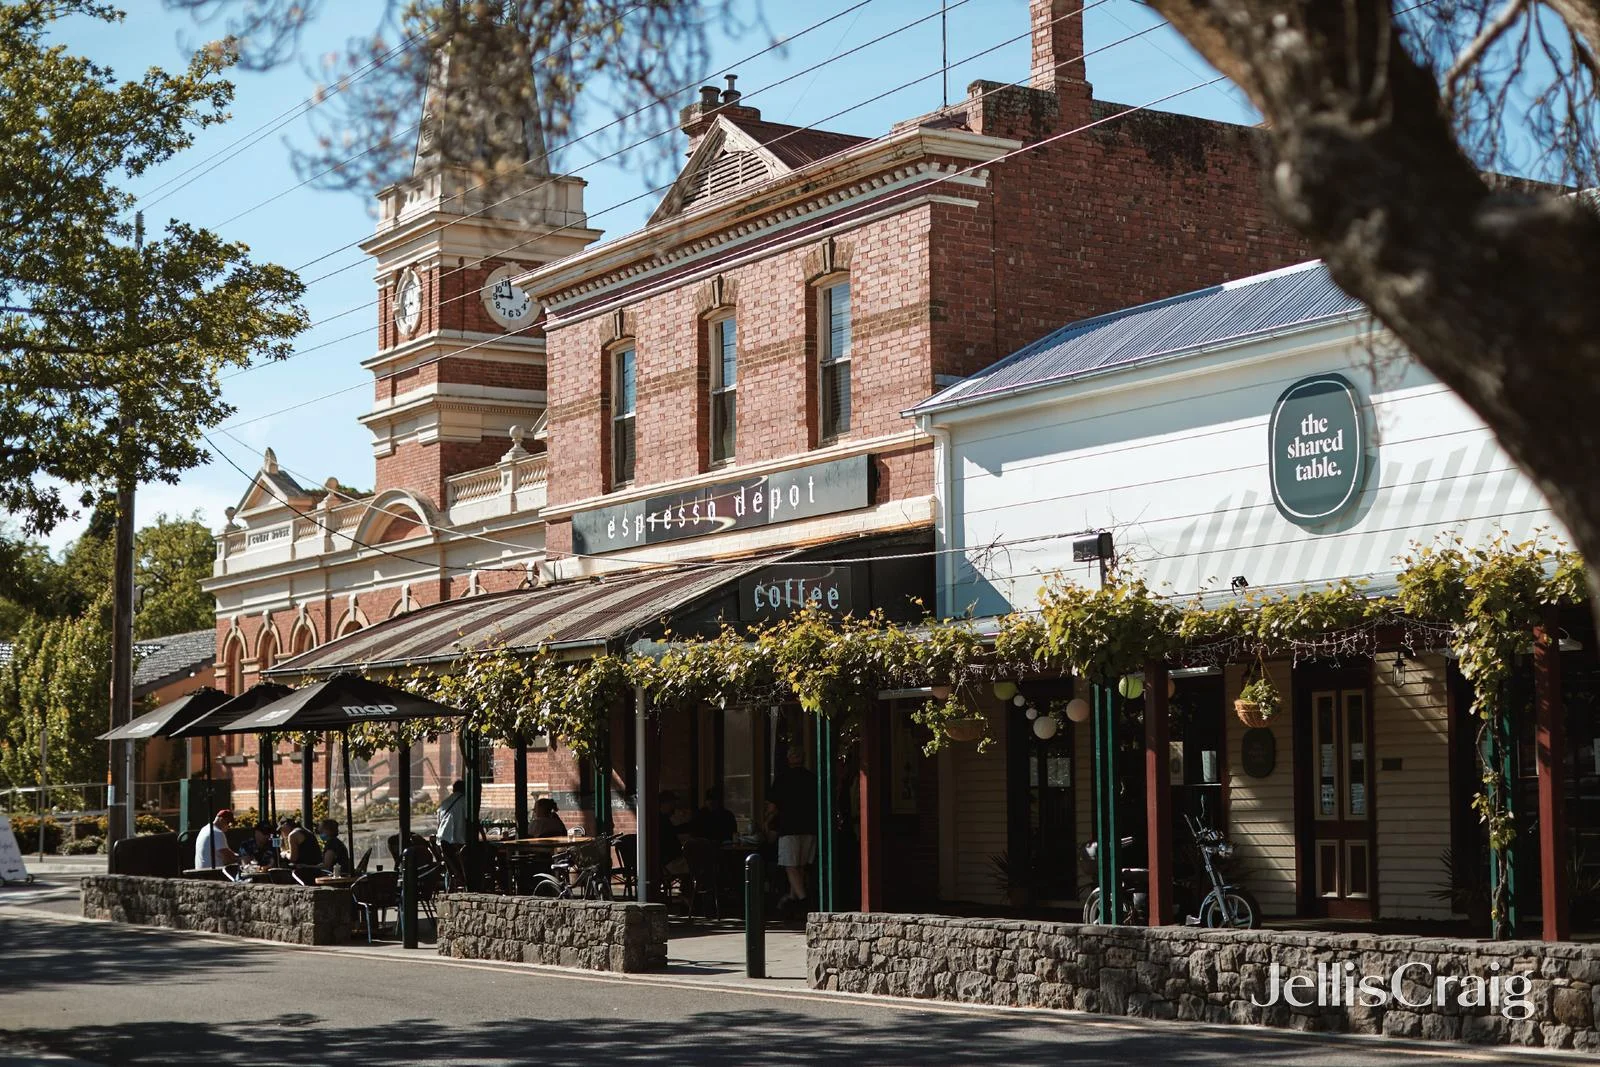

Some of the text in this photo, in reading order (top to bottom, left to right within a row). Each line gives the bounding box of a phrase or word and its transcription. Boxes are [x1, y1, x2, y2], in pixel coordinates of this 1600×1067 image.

[495, 285, 503, 293] 10
[1301, 413, 1328, 436] the
[1287, 429, 1344, 459] shared
[1295, 456, 1342, 482] table.
[607, 493, 717, 542] espresso
[754, 577, 839, 611] coffee
[342, 704, 397, 717] map
